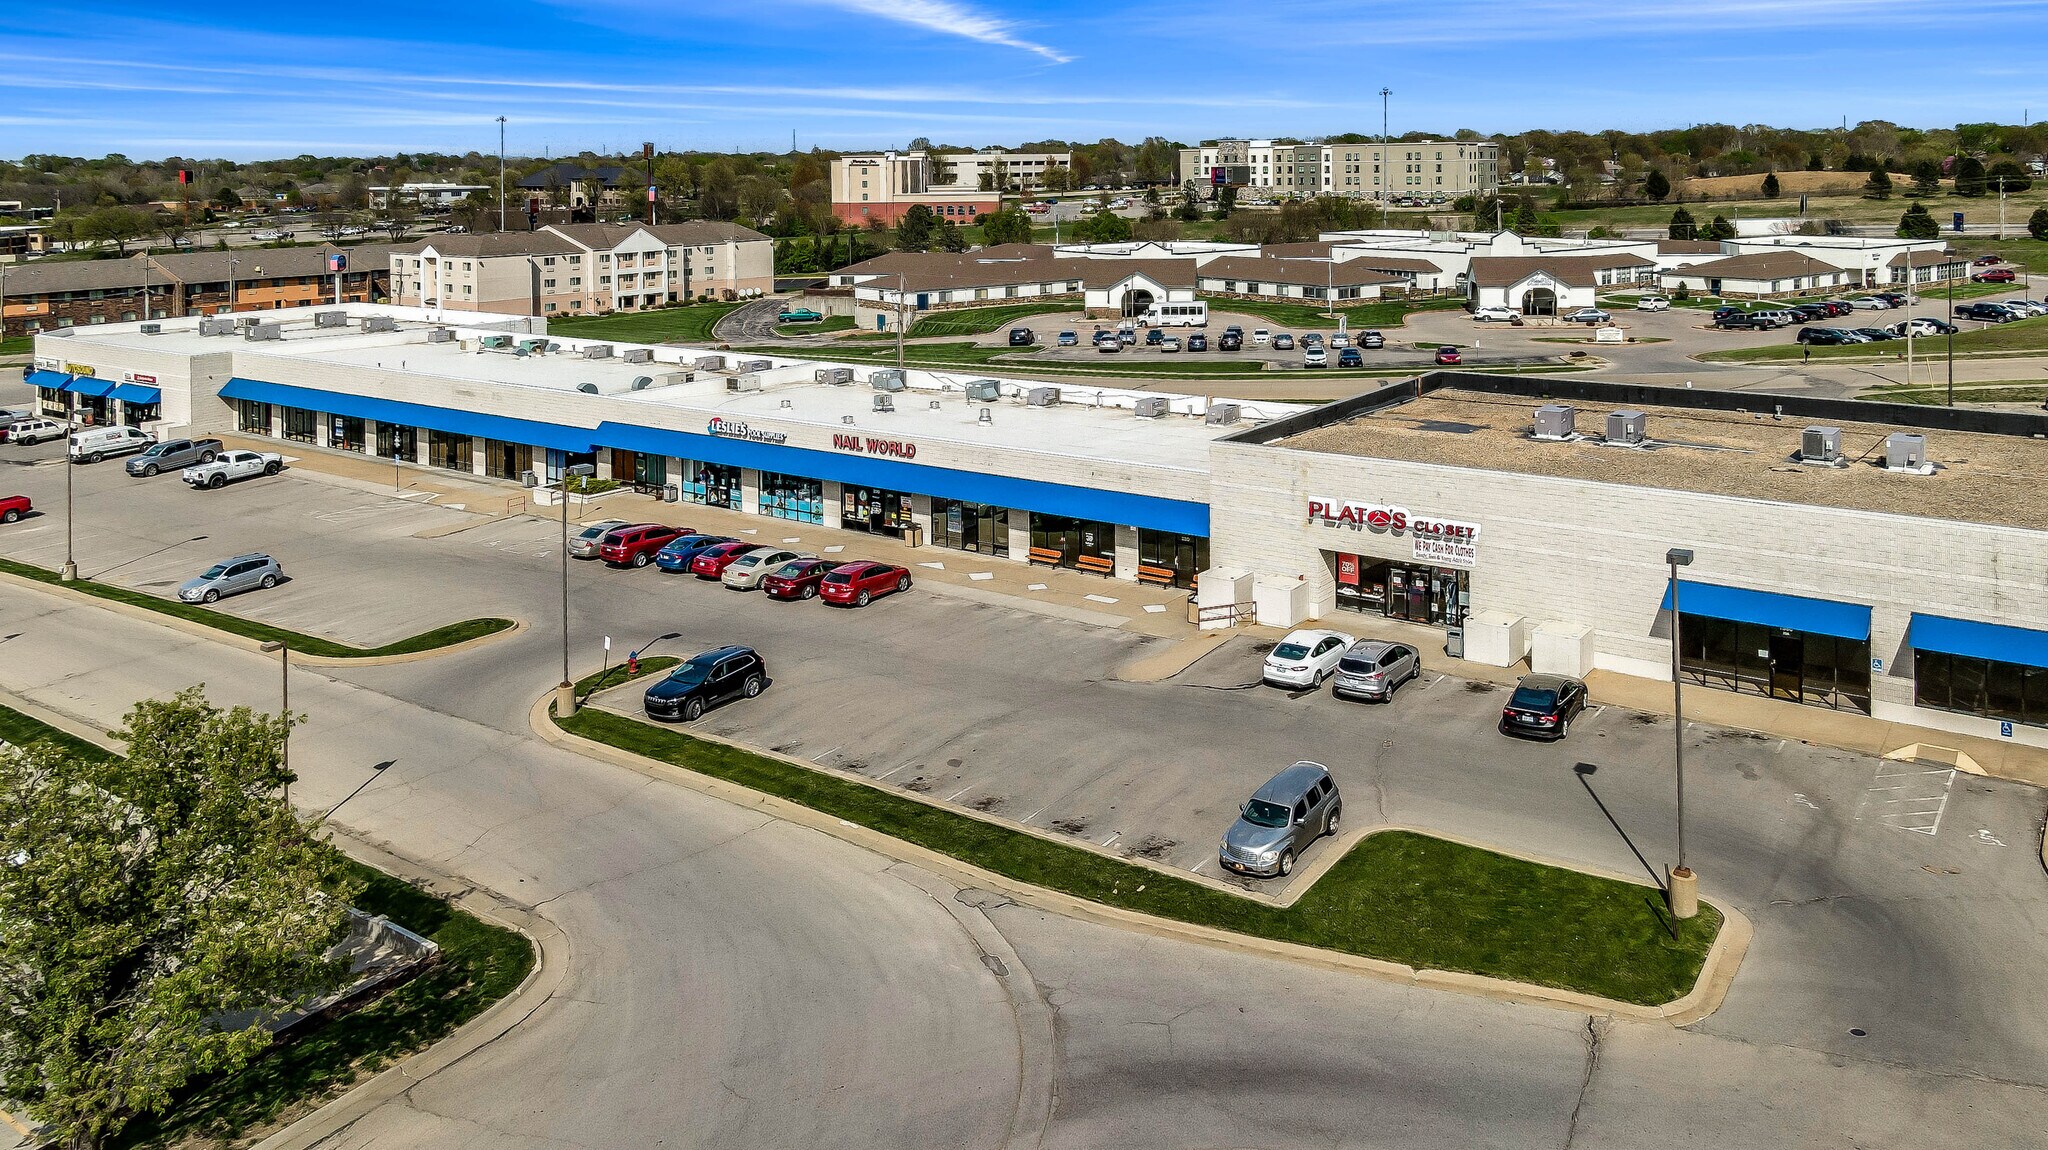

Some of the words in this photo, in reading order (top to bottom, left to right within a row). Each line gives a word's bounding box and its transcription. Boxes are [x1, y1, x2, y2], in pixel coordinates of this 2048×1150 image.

[711, 420, 748, 436] LESLIE'S
[833, 434, 863, 452] NAIL
[866, 438, 916, 459] WORLD
[1308, 501, 1407, 530] PLATO'S
[1413, 520, 1475, 539] CLOSET
[1414, 539, 1422, 551] WE
[1423, 541, 1431, 552] PAY
[1432, 542, 1444, 554] CASH
[1445, 543, 1454, 556] FOR
[1455, 545, 1474, 559] CLOTHES
